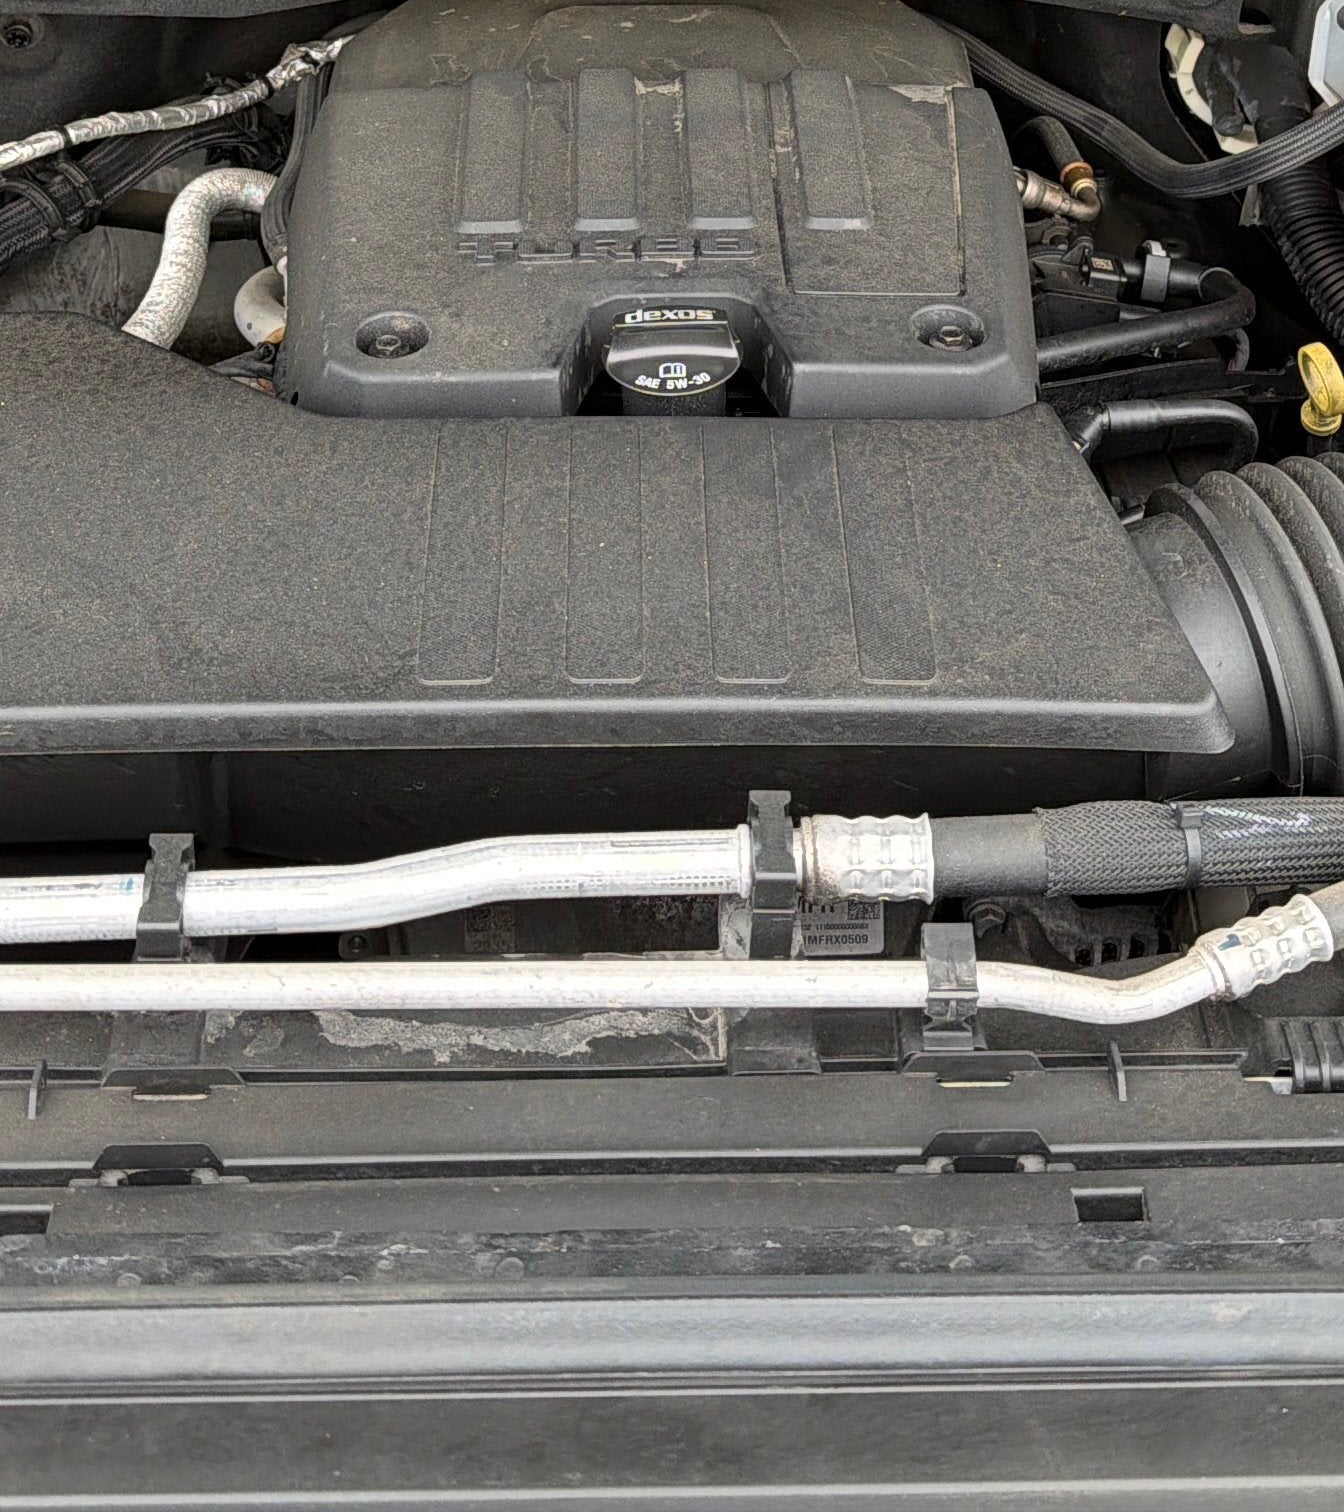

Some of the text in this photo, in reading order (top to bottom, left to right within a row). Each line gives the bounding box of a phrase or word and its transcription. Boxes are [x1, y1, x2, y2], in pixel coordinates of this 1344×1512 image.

[624, 309, 715, 324] dexos
[635, 372, 712, 390] SAE 5W-30
